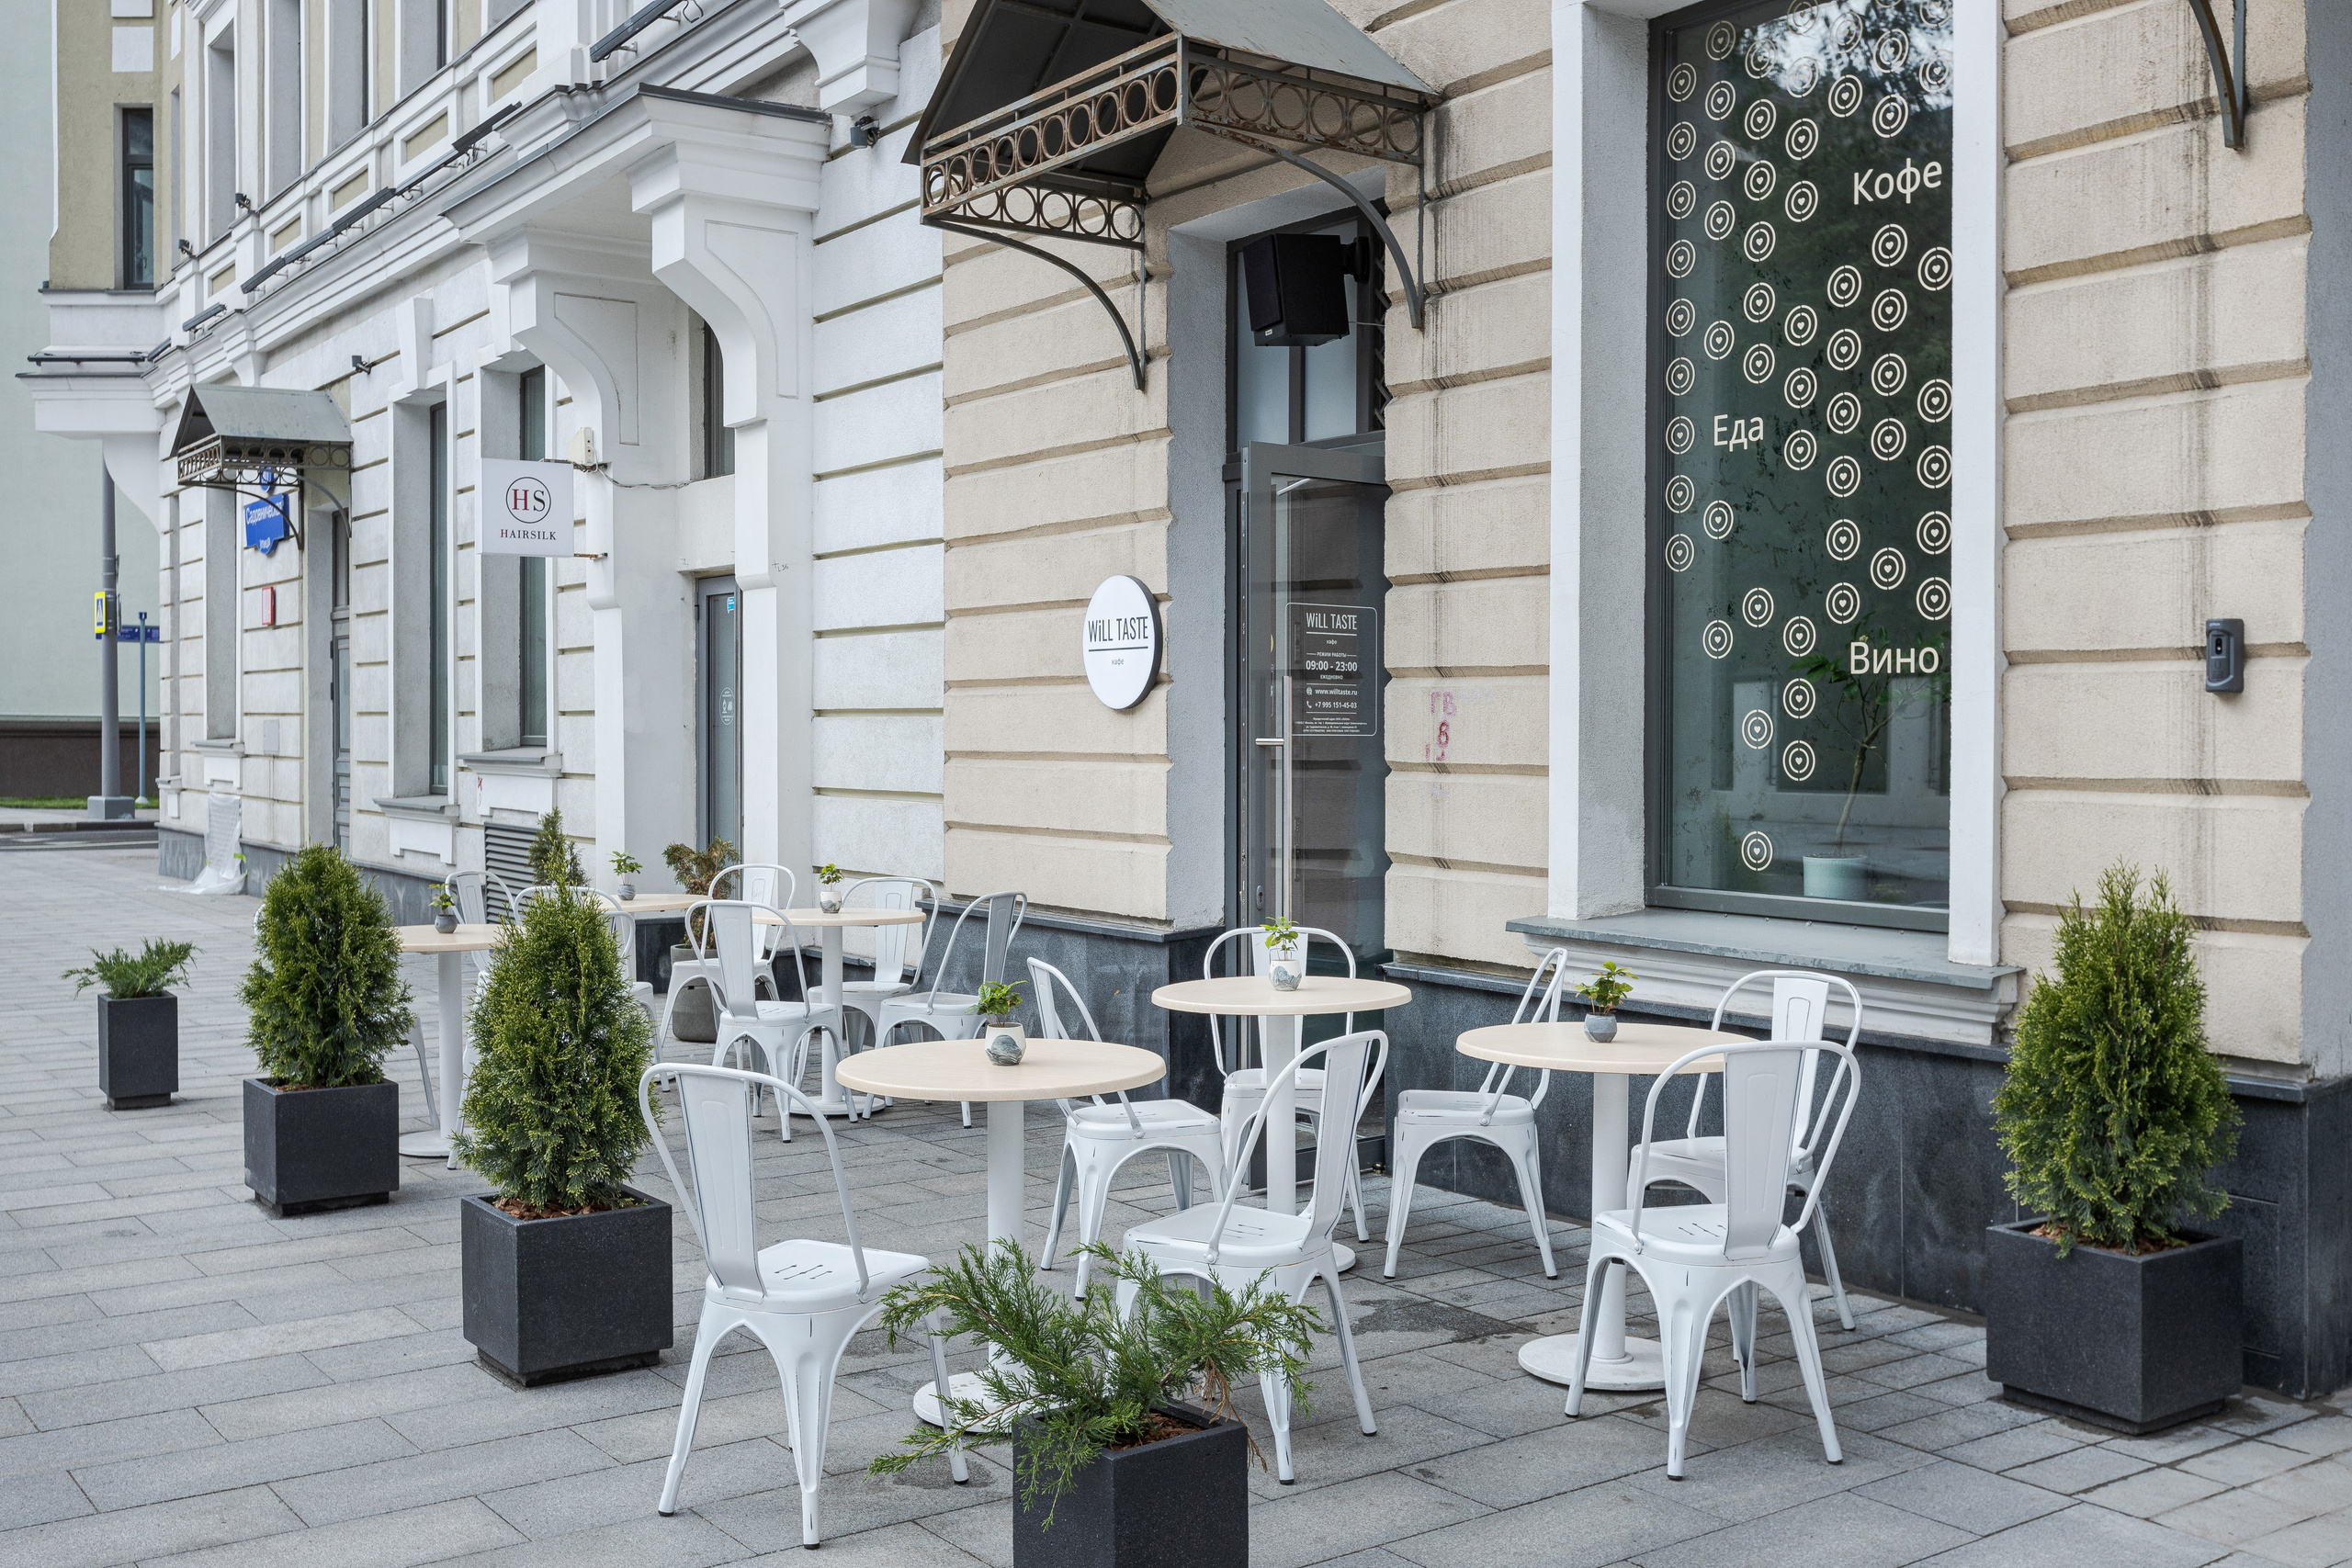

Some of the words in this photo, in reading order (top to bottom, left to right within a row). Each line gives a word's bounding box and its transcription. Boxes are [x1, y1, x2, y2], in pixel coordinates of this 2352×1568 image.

[1853, 157, 1942, 206] Кофе
[1713, 413, 1764, 453] Еда
[511, 488, 546, 513] HS
[500, 528, 557, 541] HAIRSILK
[1115, 615, 1148, 641] TASTE
[1329, 614, 1358, 630] TASTE
[1111, 658, 1125, 666] кафе
[1306, 660, 1329, 671] 09:00
[1335, 660, 1358, 671] 23:00
[1850, 641, 1939, 675] Вино
[1315, 688, 1358, 696] www.willtaste.ru
